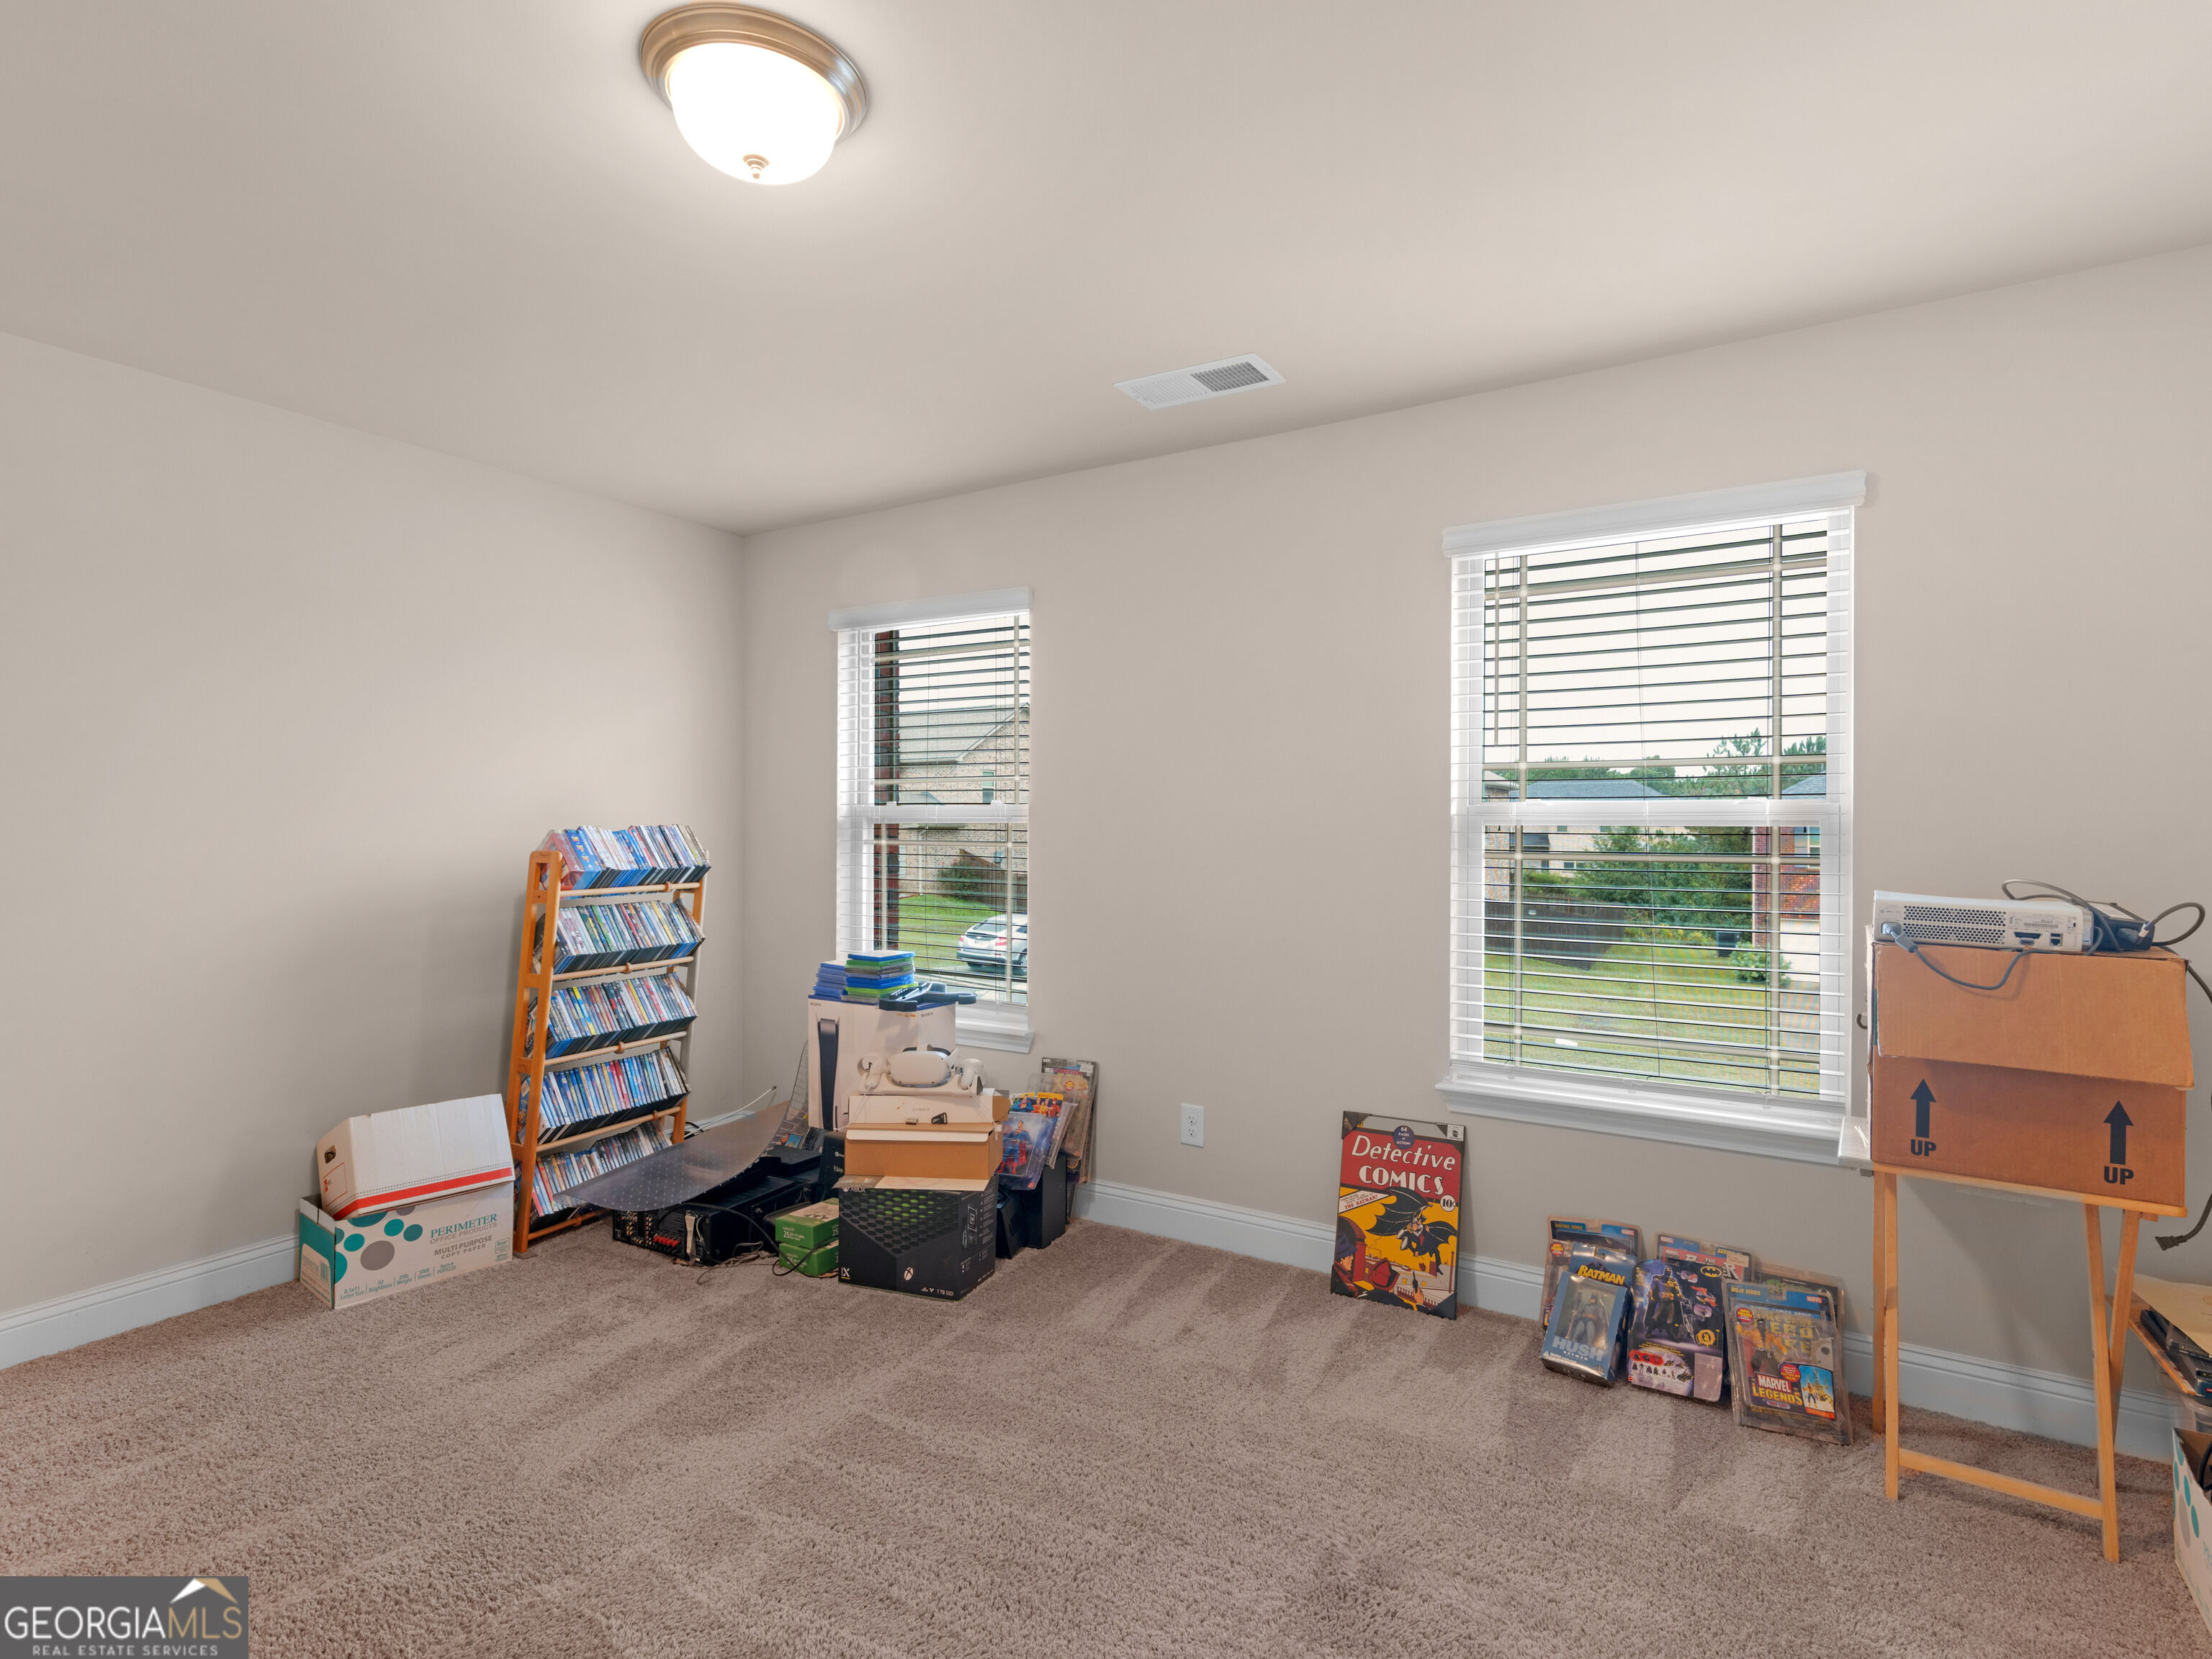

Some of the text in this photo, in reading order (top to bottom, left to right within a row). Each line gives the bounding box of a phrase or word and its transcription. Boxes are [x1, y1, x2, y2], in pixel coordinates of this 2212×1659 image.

[1351, 1135, 1456, 1171] Detective
[1910, 1138, 1937, 1156] UP
[1359, 1165, 1444, 1195] COMICS
[2103, 1166, 2134, 1185] UP
[1356, 1195, 1377, 1205] BATMAN!
[430, 1222, 498, 1244] OFFICE PRODUCTS
[431, 1213, 498, 1238] PERIMETER
[434, 1244, 457, 1256] MULTI
[459, 1234, 493, 1249] PURPOSE
[441, 1250, 460, 1259] COPY
[463, 1244, 486, 1253] PAPER
[1578, 1264, 1625, 1285] BATMAN
[343, 1285, 360, 1294] 8.5x11
[368, 1283, 392, 1292] Brightness
[1552, 1336, 1604, 1362] HUSH
[1751, 1382, 1803, 1406] LEGENDS
[1758, 1375, 1791, 1393] MARVEL
